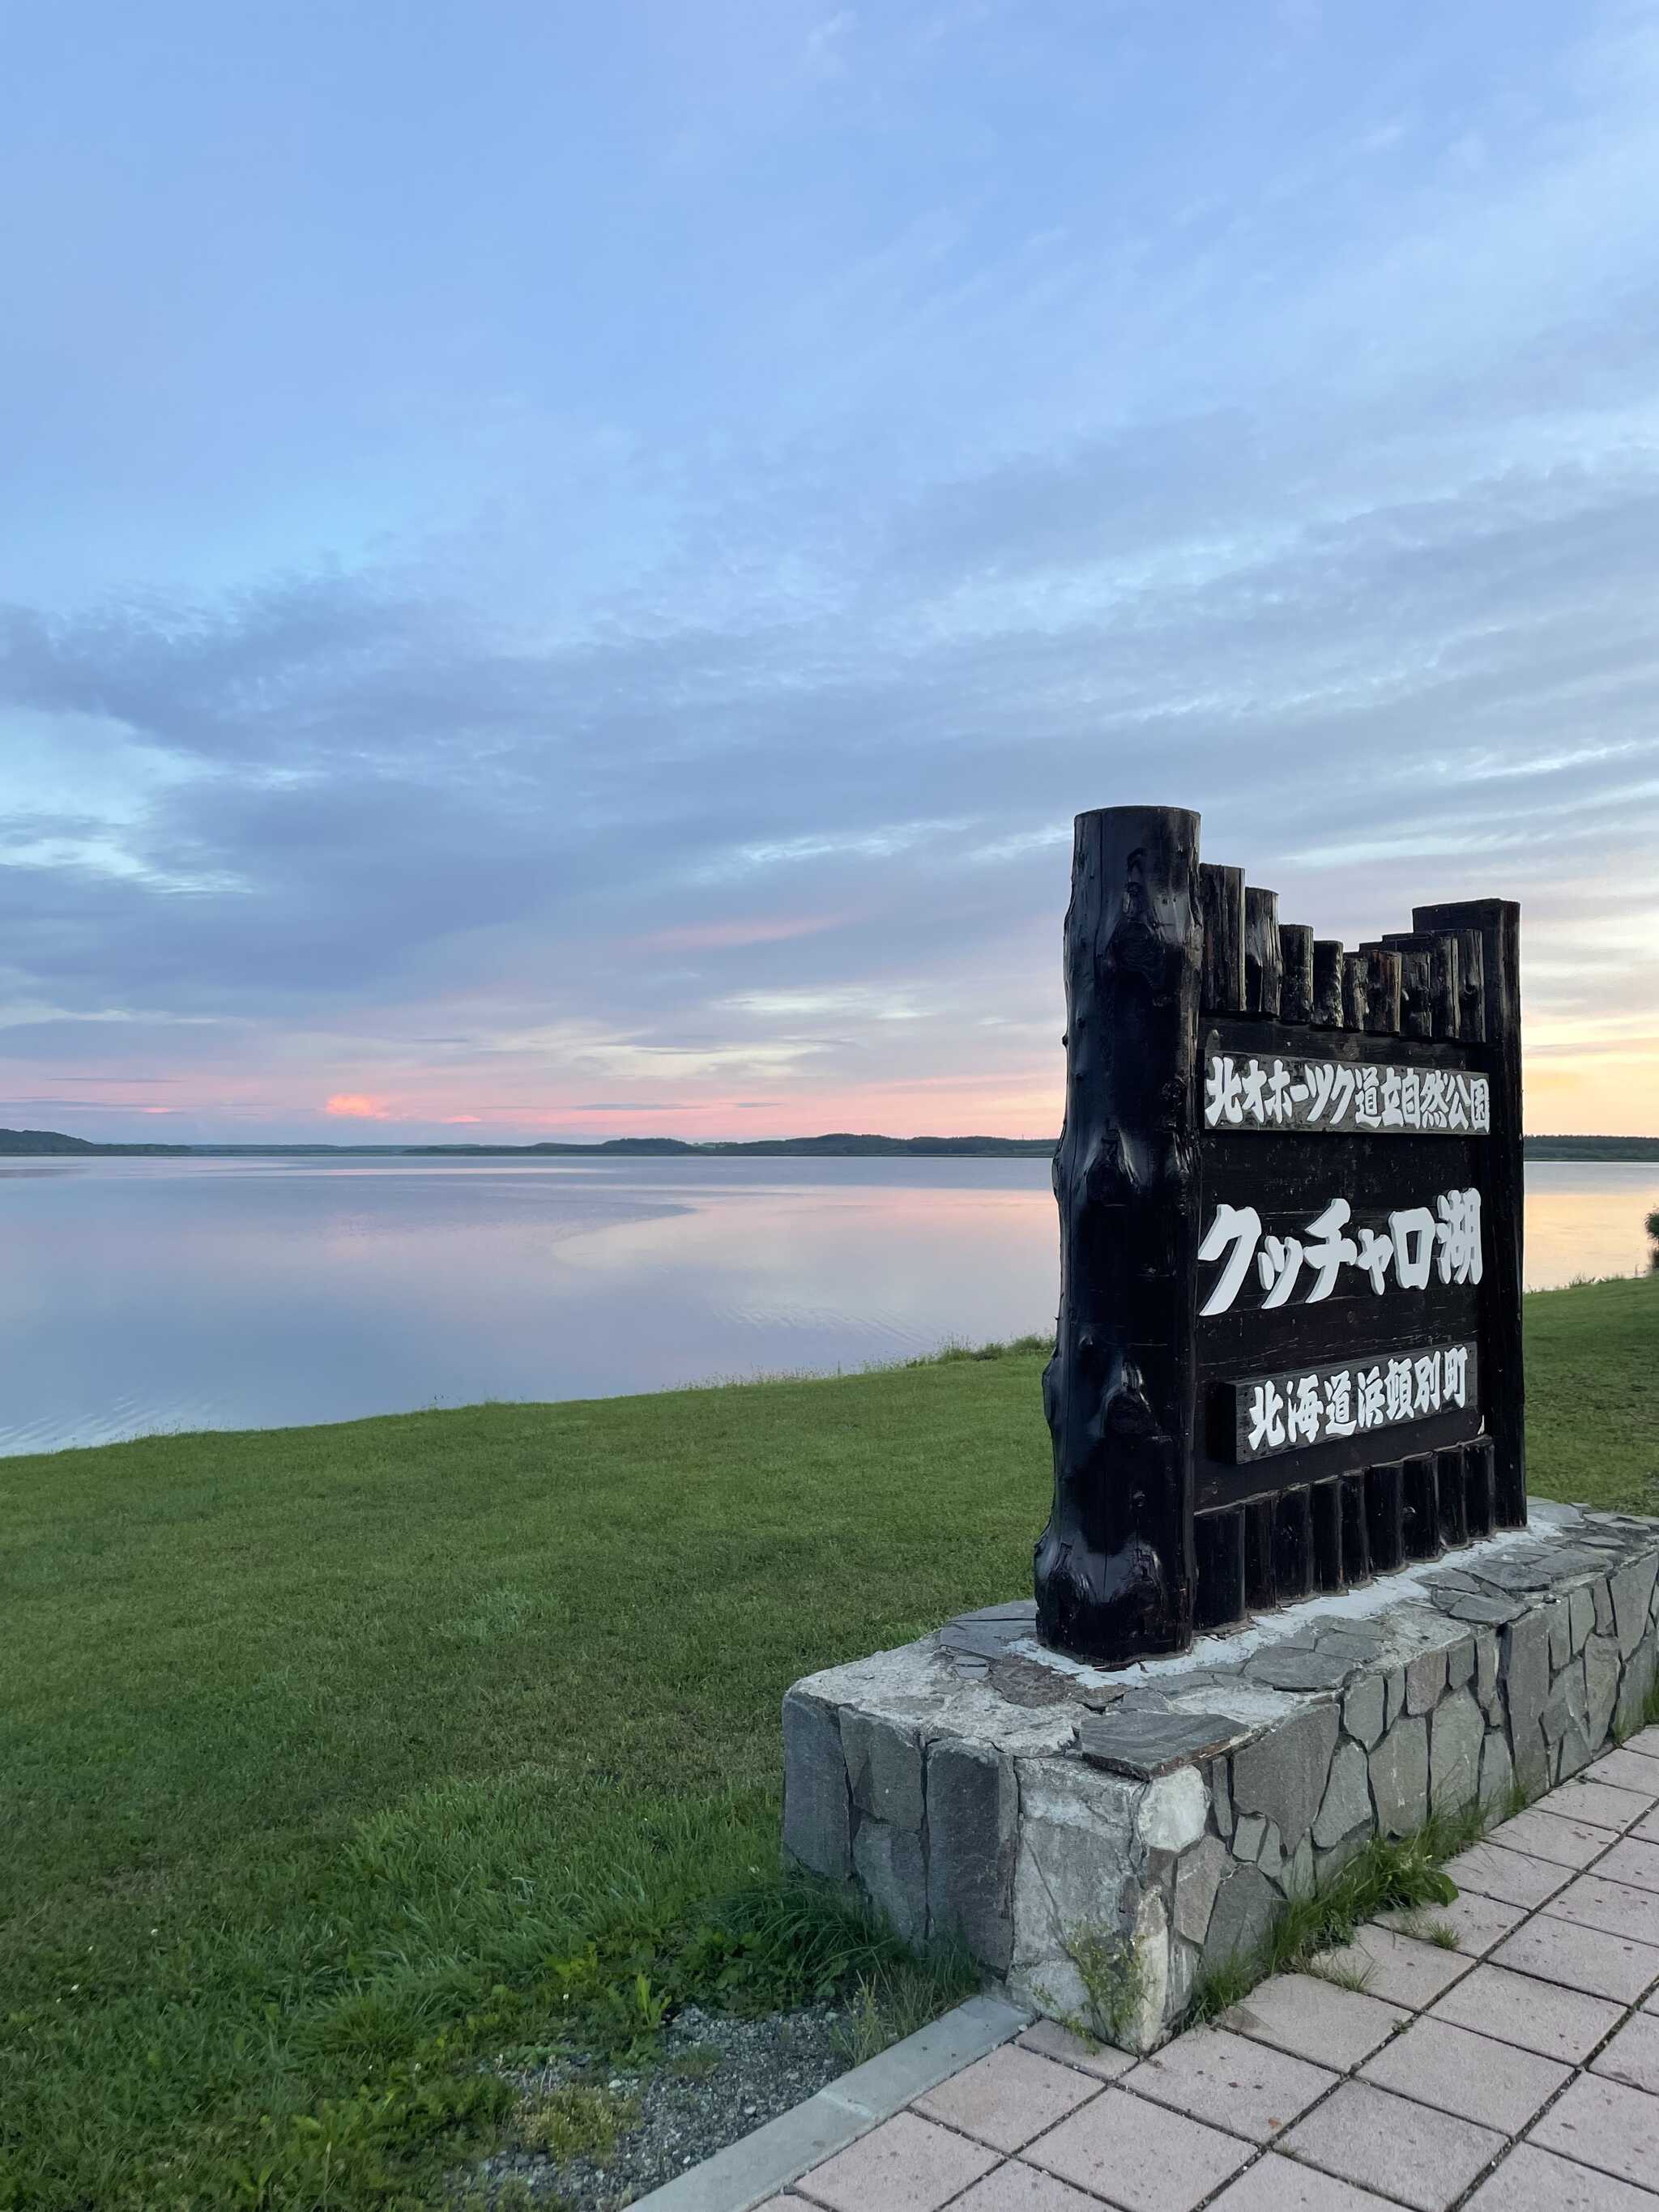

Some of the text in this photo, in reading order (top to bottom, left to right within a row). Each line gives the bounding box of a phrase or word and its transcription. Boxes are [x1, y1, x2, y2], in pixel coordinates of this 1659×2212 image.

[1205, 1055, 1491, 1133] 北オホーツク道立自然公園
[1197, 1187, 1483, 1316] クッチャロ湖
[1247, 1346, 1468, 1451] 北海道浜頓別町
